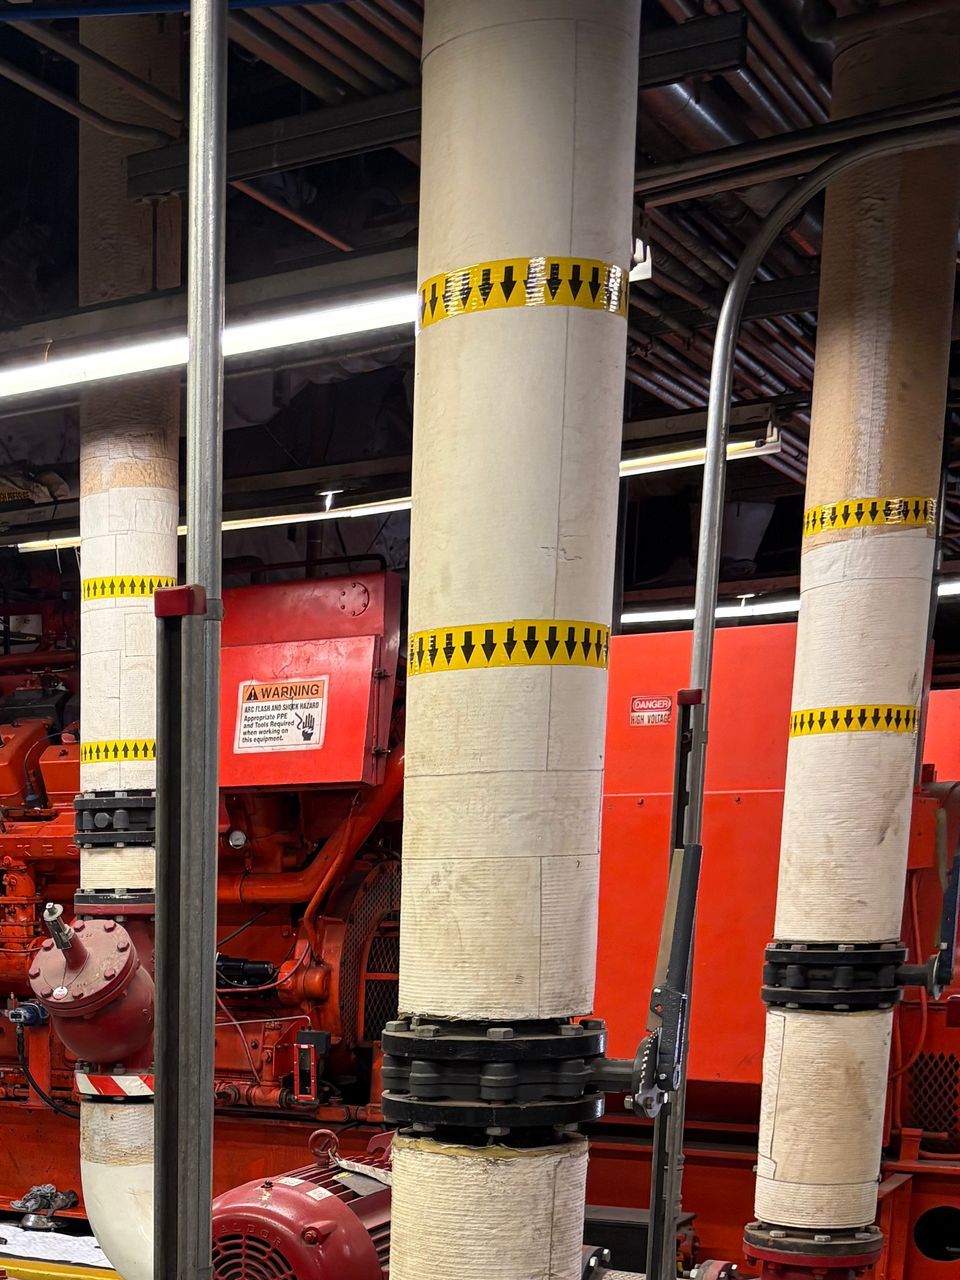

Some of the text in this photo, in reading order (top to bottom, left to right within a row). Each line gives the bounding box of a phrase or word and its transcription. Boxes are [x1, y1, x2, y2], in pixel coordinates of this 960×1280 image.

[261, 684, 320, 699] WARNING
[244, 705, 254, 713] ARC
[255, 704, 270, 712] FLASH
[282, 703, 299, 711] SHOCK
[300, 702, 319, 710] HAZARD
[635, 700, 668, 709] DANGER
[244, 714, 275, 722] Appropriate
[270, 720, 294, 728] Required
[258, 728, 280, 736] working
